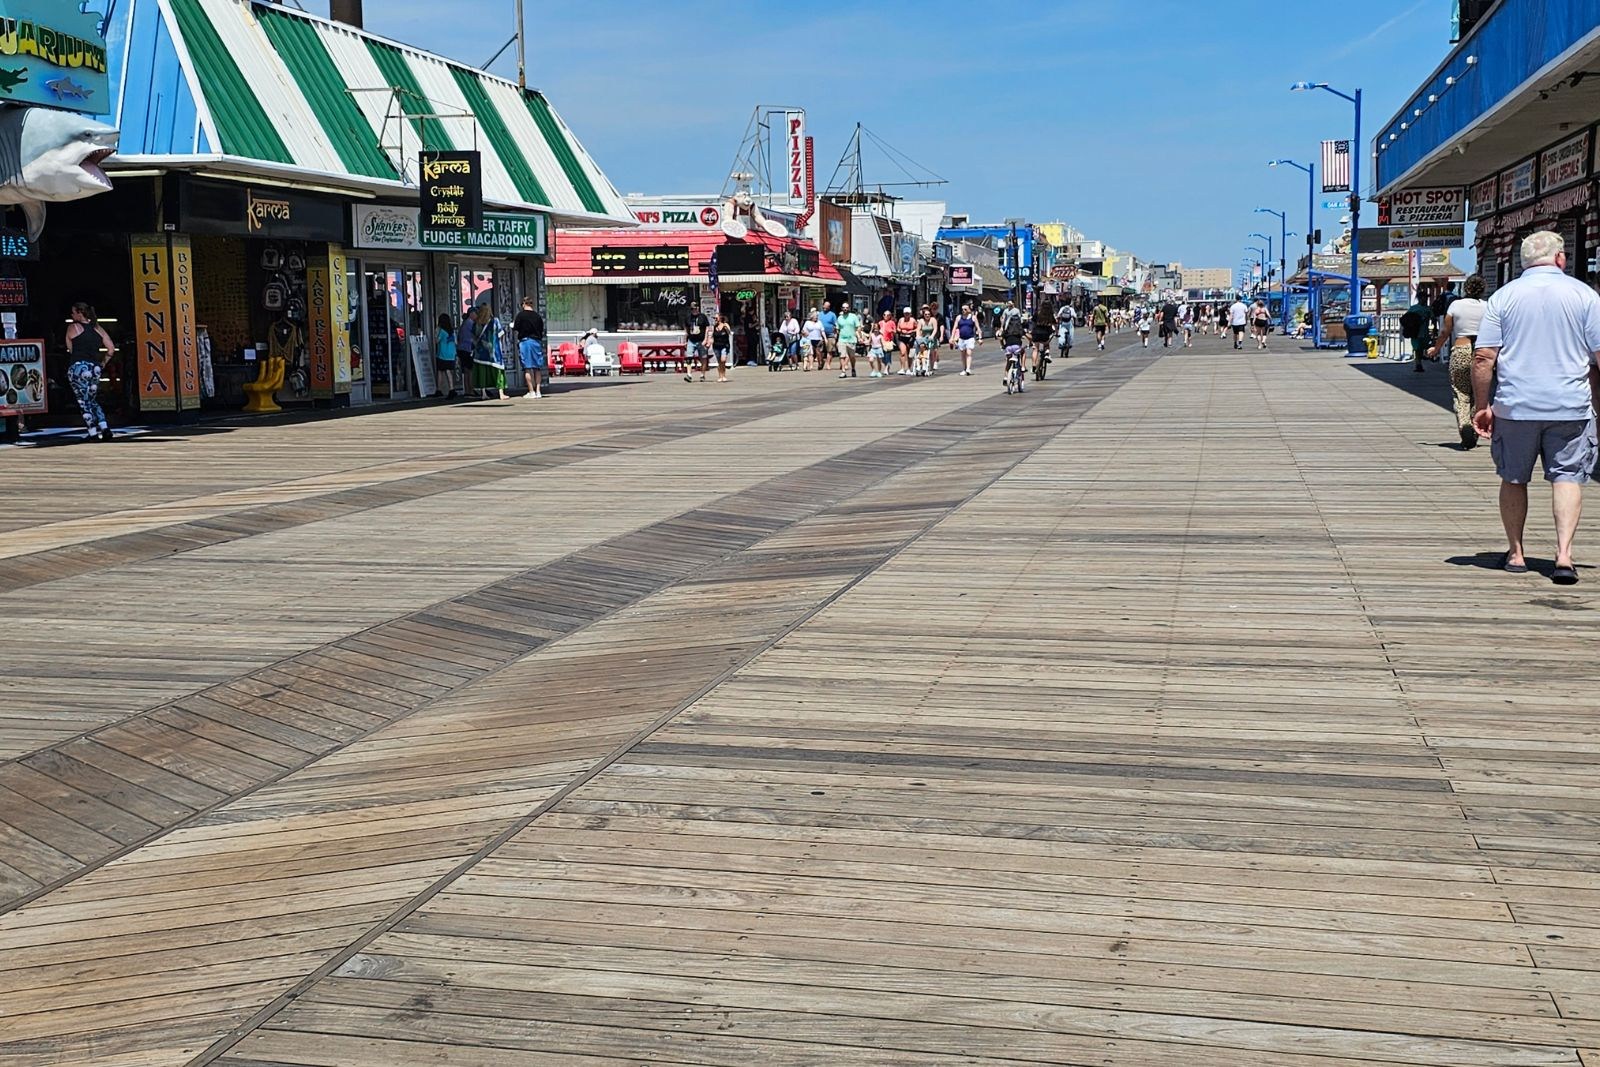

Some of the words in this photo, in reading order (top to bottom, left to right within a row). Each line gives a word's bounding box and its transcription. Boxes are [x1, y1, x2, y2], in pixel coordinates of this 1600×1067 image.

[789, 119, 803, 199] PIZZA
[423, 156, 471, 182] Karma
[430, 185, 465, 198] Crystals
[1393, 191, 1422, 206] HOT
[1426, 189, 1463, 204] SPOT
[247, 188, 290, 233] Karma
[436, 201, 459, 216] Body
[662, 211, 698, 223] PIZZA
[1395, 204, 1460, 215] RESTAURANT
[1398, 214, 1406, 222] &
[1408, 212, 1453, 221] PIZZERIA
[431, 214, 466, 228] Piercing
[498, 220, 530, 233] TAFFY
[423, 230, 462, 244] FUDGE
[467, 232, 534, 247] MACAROONS
[177, 252, 189, 296] BODY
[312, 269, 324, 315] TAROT
[737, 290, 754, 300] OPEN
[139, 252, 168, 392] HENNA
[333, 257, 346, 380] CRYSTALS
[0, 346, 36, 361] ARIUM
[180, 303, 194, 392] PIERCING
